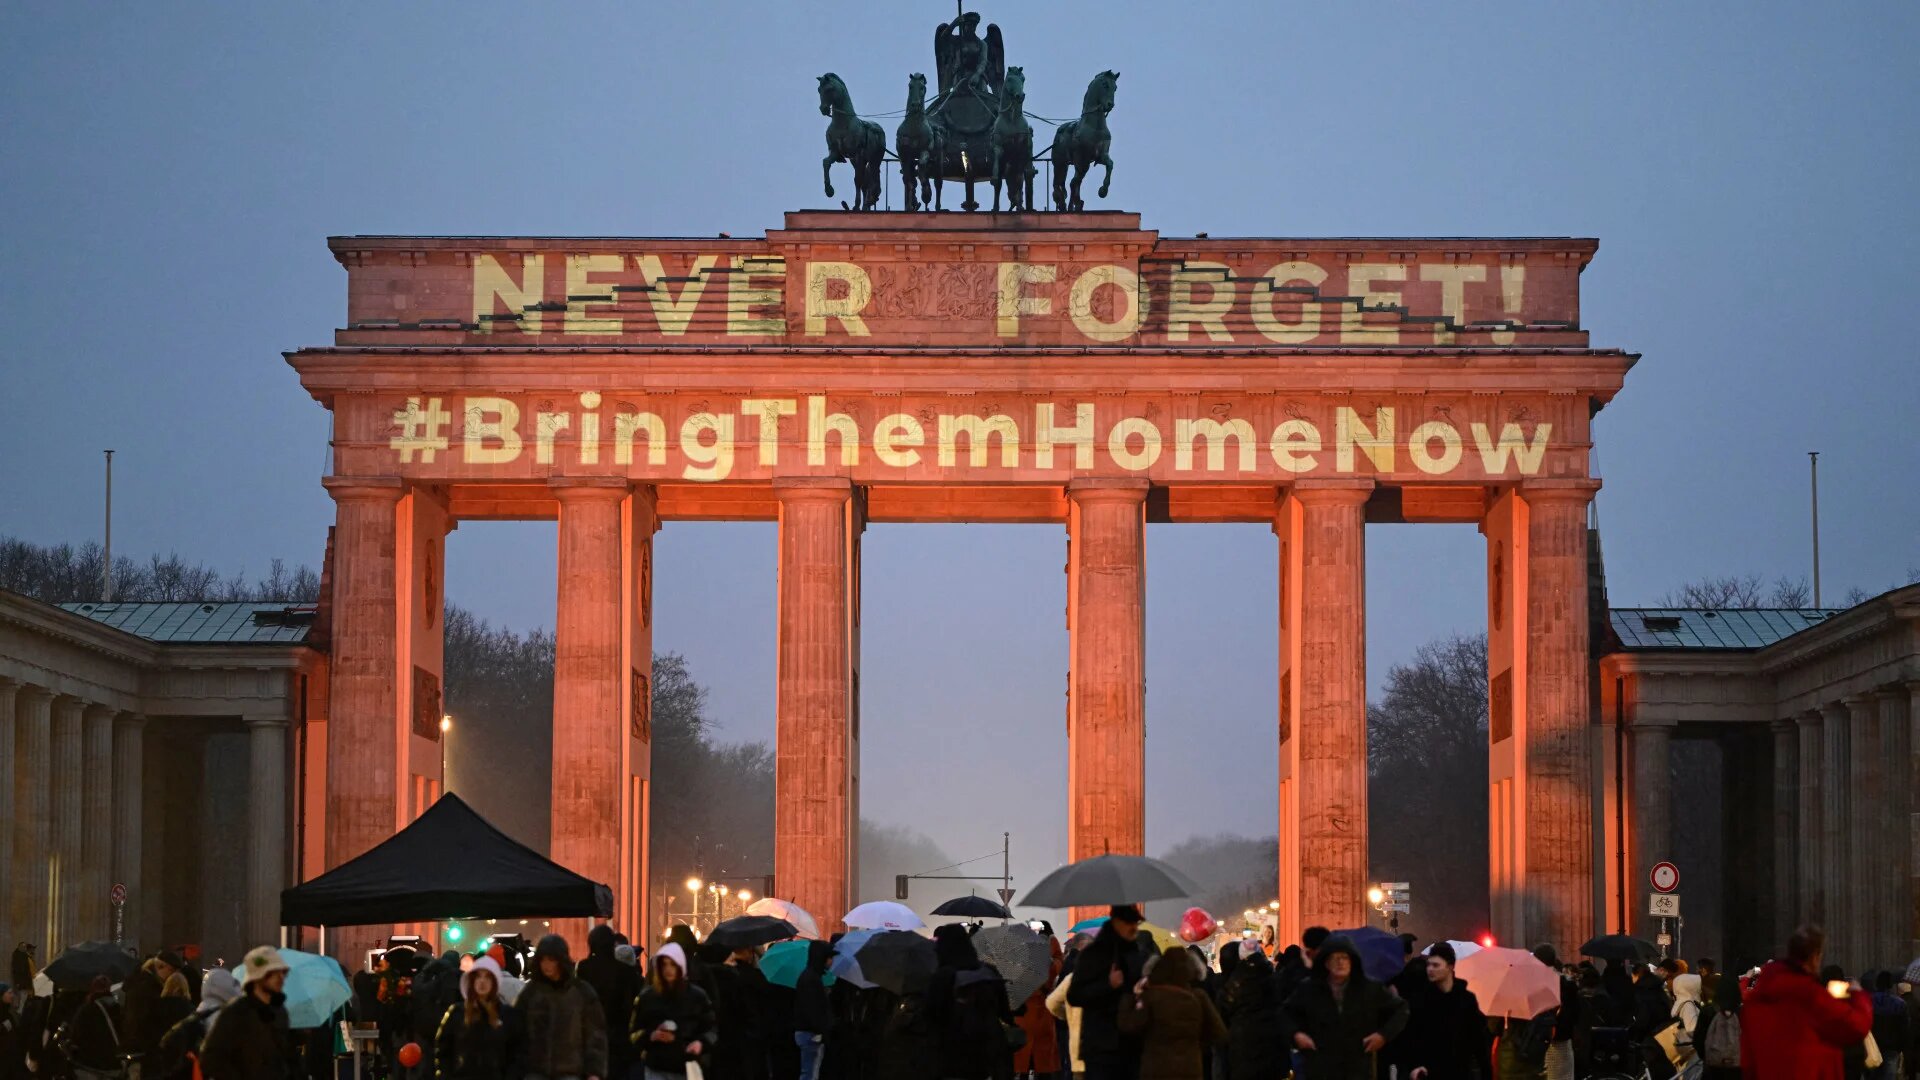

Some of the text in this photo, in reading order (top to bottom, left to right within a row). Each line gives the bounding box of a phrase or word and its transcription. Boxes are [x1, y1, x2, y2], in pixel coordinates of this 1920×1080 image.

[472, 254, 1526, 346] NEVER FORGET!
[390, 391, 1553, 482] #BringThemHomeNow
